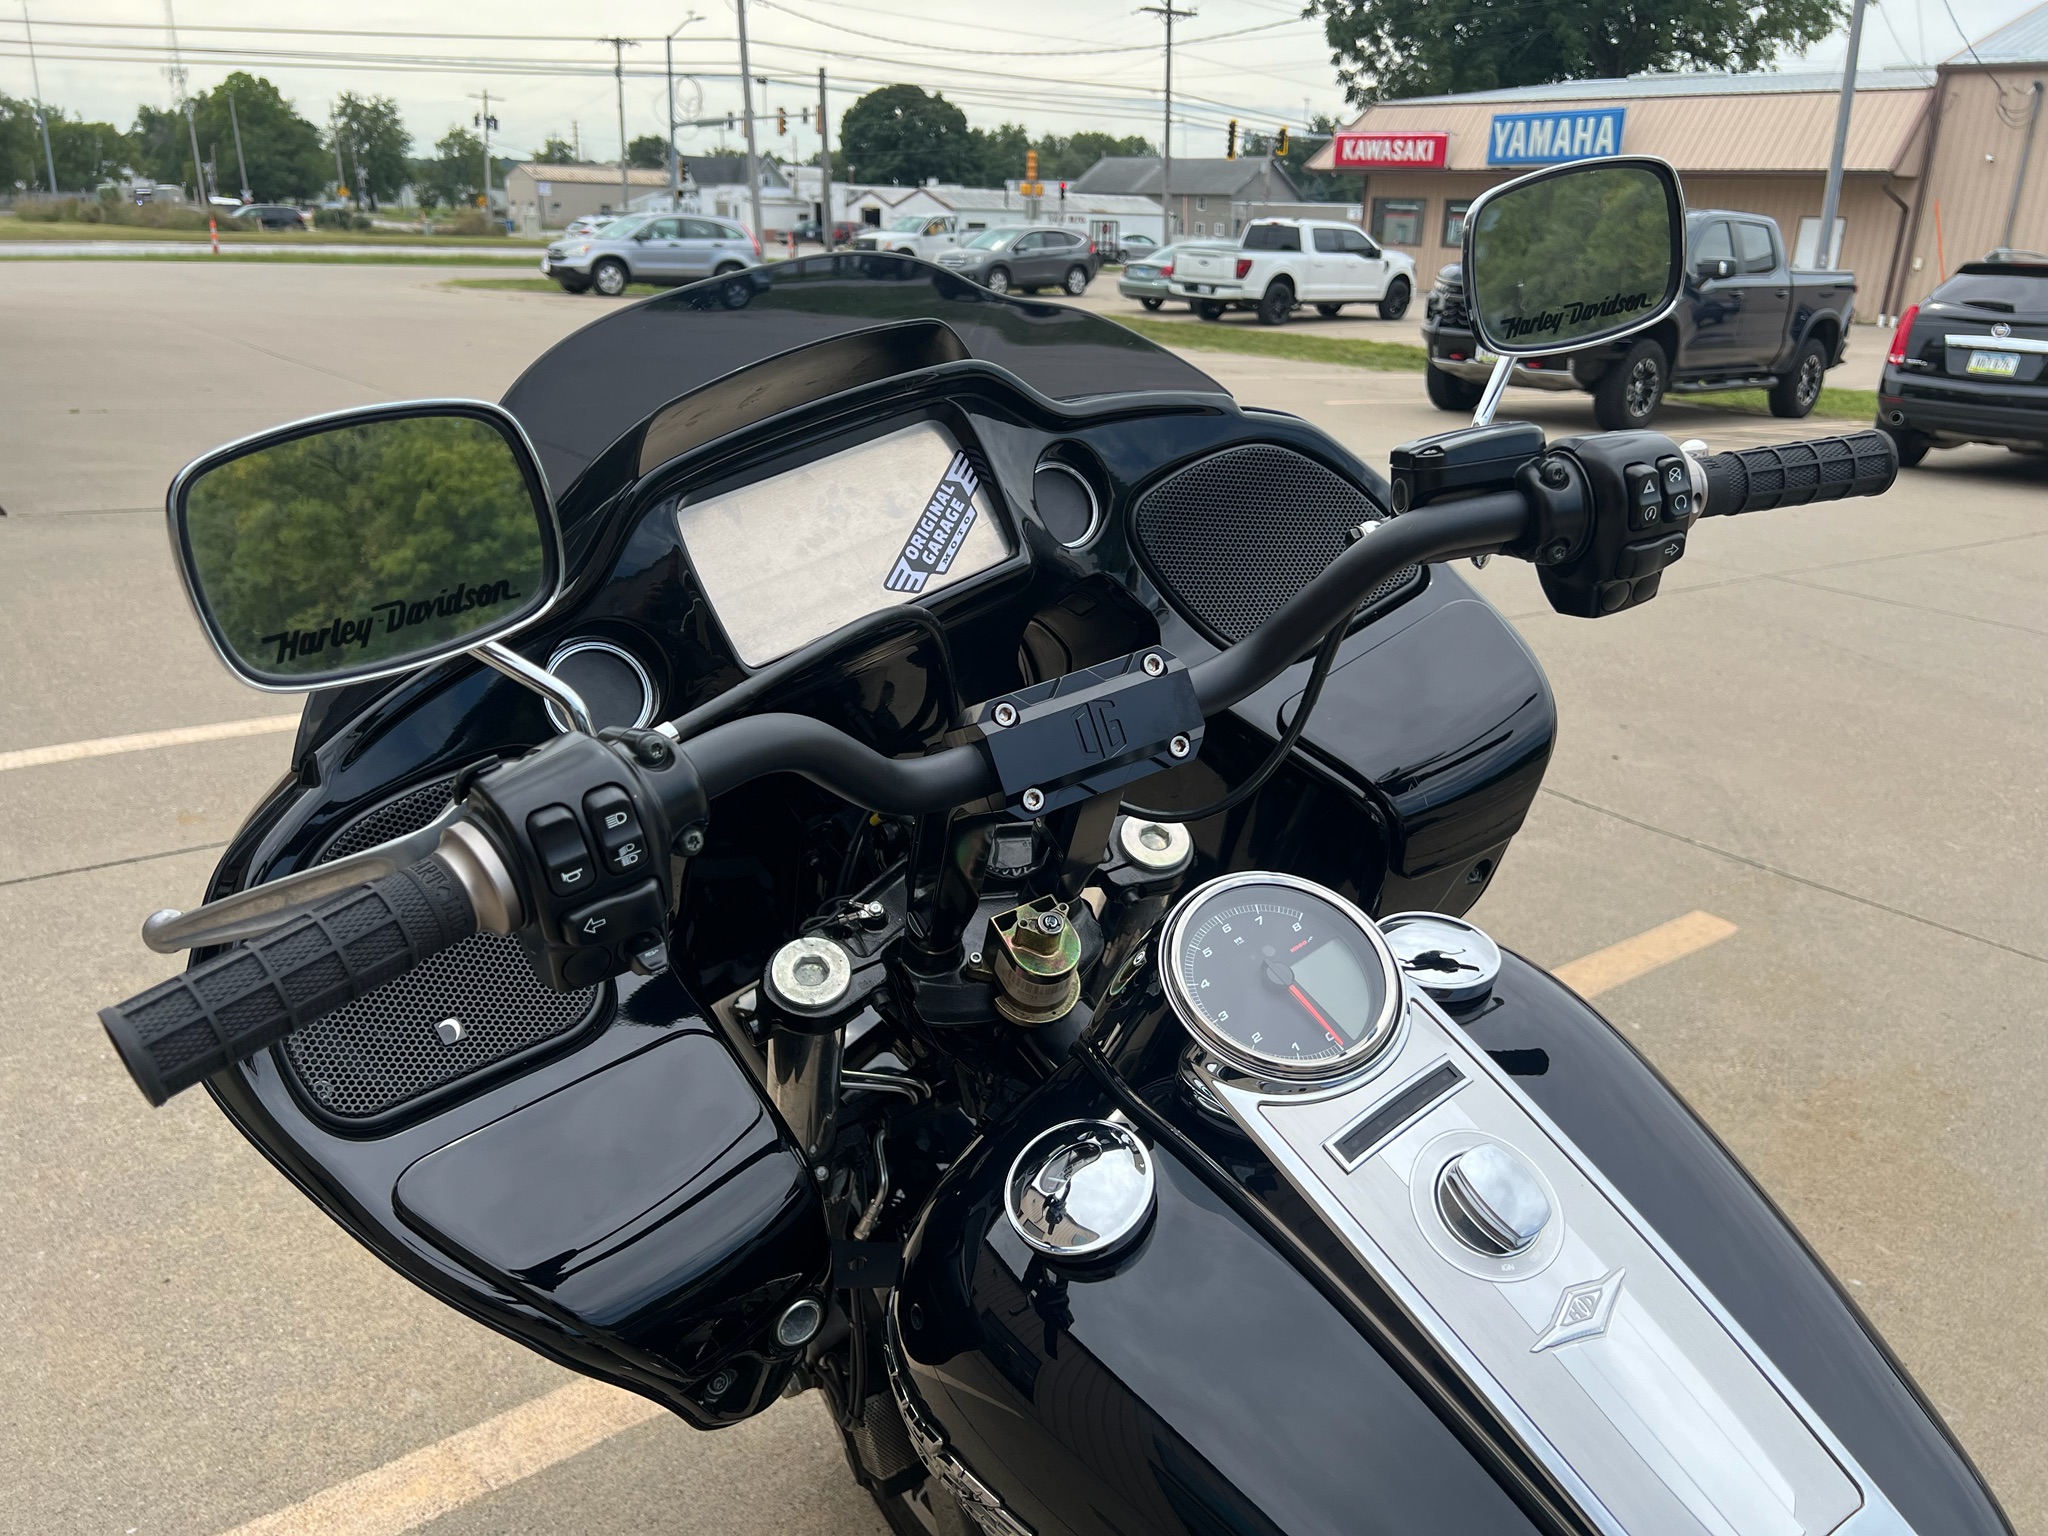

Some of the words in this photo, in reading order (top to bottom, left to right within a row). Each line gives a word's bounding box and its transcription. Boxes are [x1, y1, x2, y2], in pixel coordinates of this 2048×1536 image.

[1494, 115, 1614, 158] YAMAHA
[1341, 138, 1435, 161] KAWASAKI
[1500, 293, 1653, 340] Harley-Davidson
[905, 483, 955, 560] ORIGINAL
[921, 497, 966, 565] GARAGE
[942, 516, 971, 566] MOTO
[261, 579, 521, 664] Harley-Davidson
[1254, 915, 1264, 926] 7
[1291, 922, 1302, 932] 8
[1221, 923, 1232, 934] 6
[1202, 947, 1213, 958] 5
[1200, 978, 1210, 989] 4
[1218, 1010, 1229, 1022] 3
[1251, 1031, 1263, 1044] 2
[1291, 1042, 1301, 1051] 1
